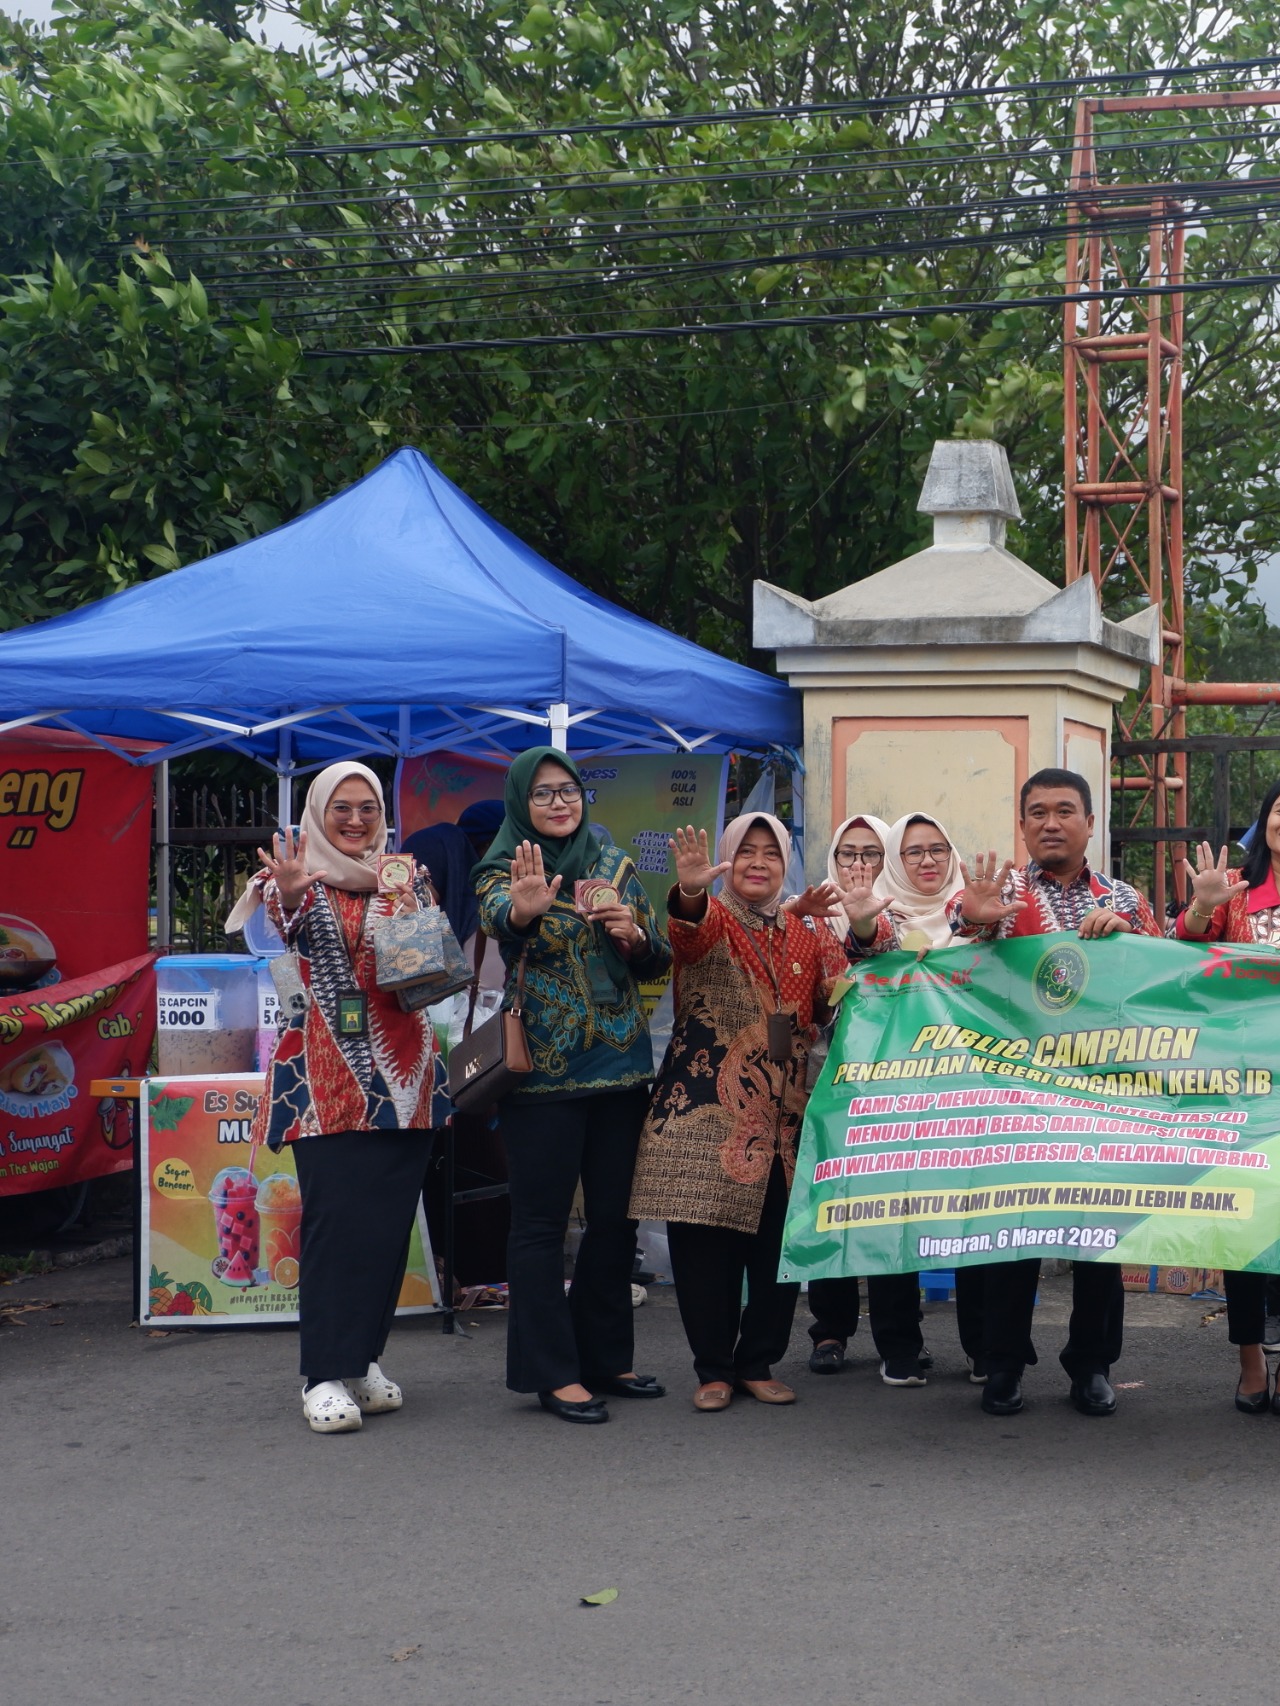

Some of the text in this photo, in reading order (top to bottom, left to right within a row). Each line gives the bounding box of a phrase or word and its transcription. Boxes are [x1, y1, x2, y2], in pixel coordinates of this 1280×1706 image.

[671, 770, 697, 780] 100%
[670, 783, 696, 793] GULA
[672, 796, 694, 806] ASLI
[639, 831, 673, 840] NIKMATI
[641, 847, 668, 856] DALAM
[640, 855, 667, 865] SETIAP
[168, 997, 208, 1007] CAPCIN
[265, 996, 276, 1007] ES
[160, 1010, 205, 1026] 5.000
[909, 1024, 1199, 1068] PUBLIC CAMPAIGN
[832, 1054, 1273, 1097] PENGADILAN NEGERI UNGARAN KELAS IB
[37, 1085, 78, 1117] Mayo
[204, 1090, 229, 1113] Es
[848, 1095, 895, 1116] KAMI
[895, 1092, 937, 1114] SIAP
[935, 1088, 1059, 1110] MEWUJUDKAN
[1058, 1095, 1108, 1112] ZONA
[1107, 1104, 1215, 1124] INTEGRITAS
[845, 1114, 1240, 1146] MENUJU WILAYAH BEBAS DARI KORUPSI (WBK)
[9, 1162, 27, 1175] The
[29, 1158, 59, 1174] Wajan
[813, 1142, 1270, 1184] DAN WILAYAH BIROKRASI BERSIH & MELAYANI (WBBM).
[826, 1187, 1240, 1224] TOLONG BANTU KAMI UNTUK MENJADI LEBIH BAIK.
[918, 1225, 1117, 1258] Ungaran, 6 Maret 2026
[254, 1303, 286, 1312] SETIAP
